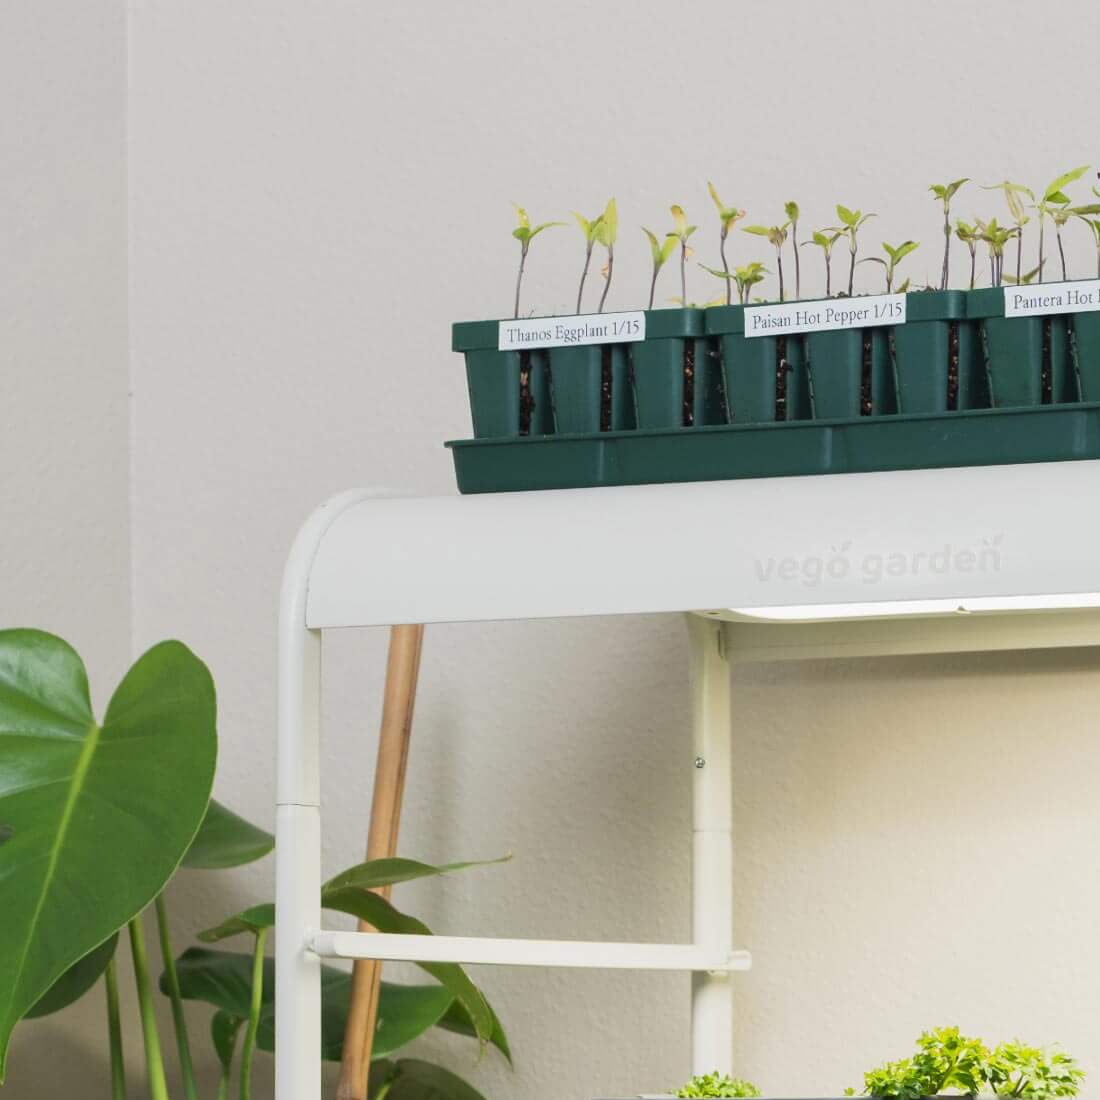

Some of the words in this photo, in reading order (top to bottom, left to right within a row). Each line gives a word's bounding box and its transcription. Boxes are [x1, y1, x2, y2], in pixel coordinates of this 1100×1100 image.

[1013, 293, 1063, 310] Pantera
[1067, 290, 1093, 306] Hot
[752, 313, 791, 330] Paisan
[796, 310, 821, 326] Hot
[826, 307, 870, 325] Pepper
[874, 302, 903, 318] 1/15
[507, 327, 552, 343] Thanos
[555, 323, 608, 343] Eggplant
[613, 319, 640, 336] 1/15
